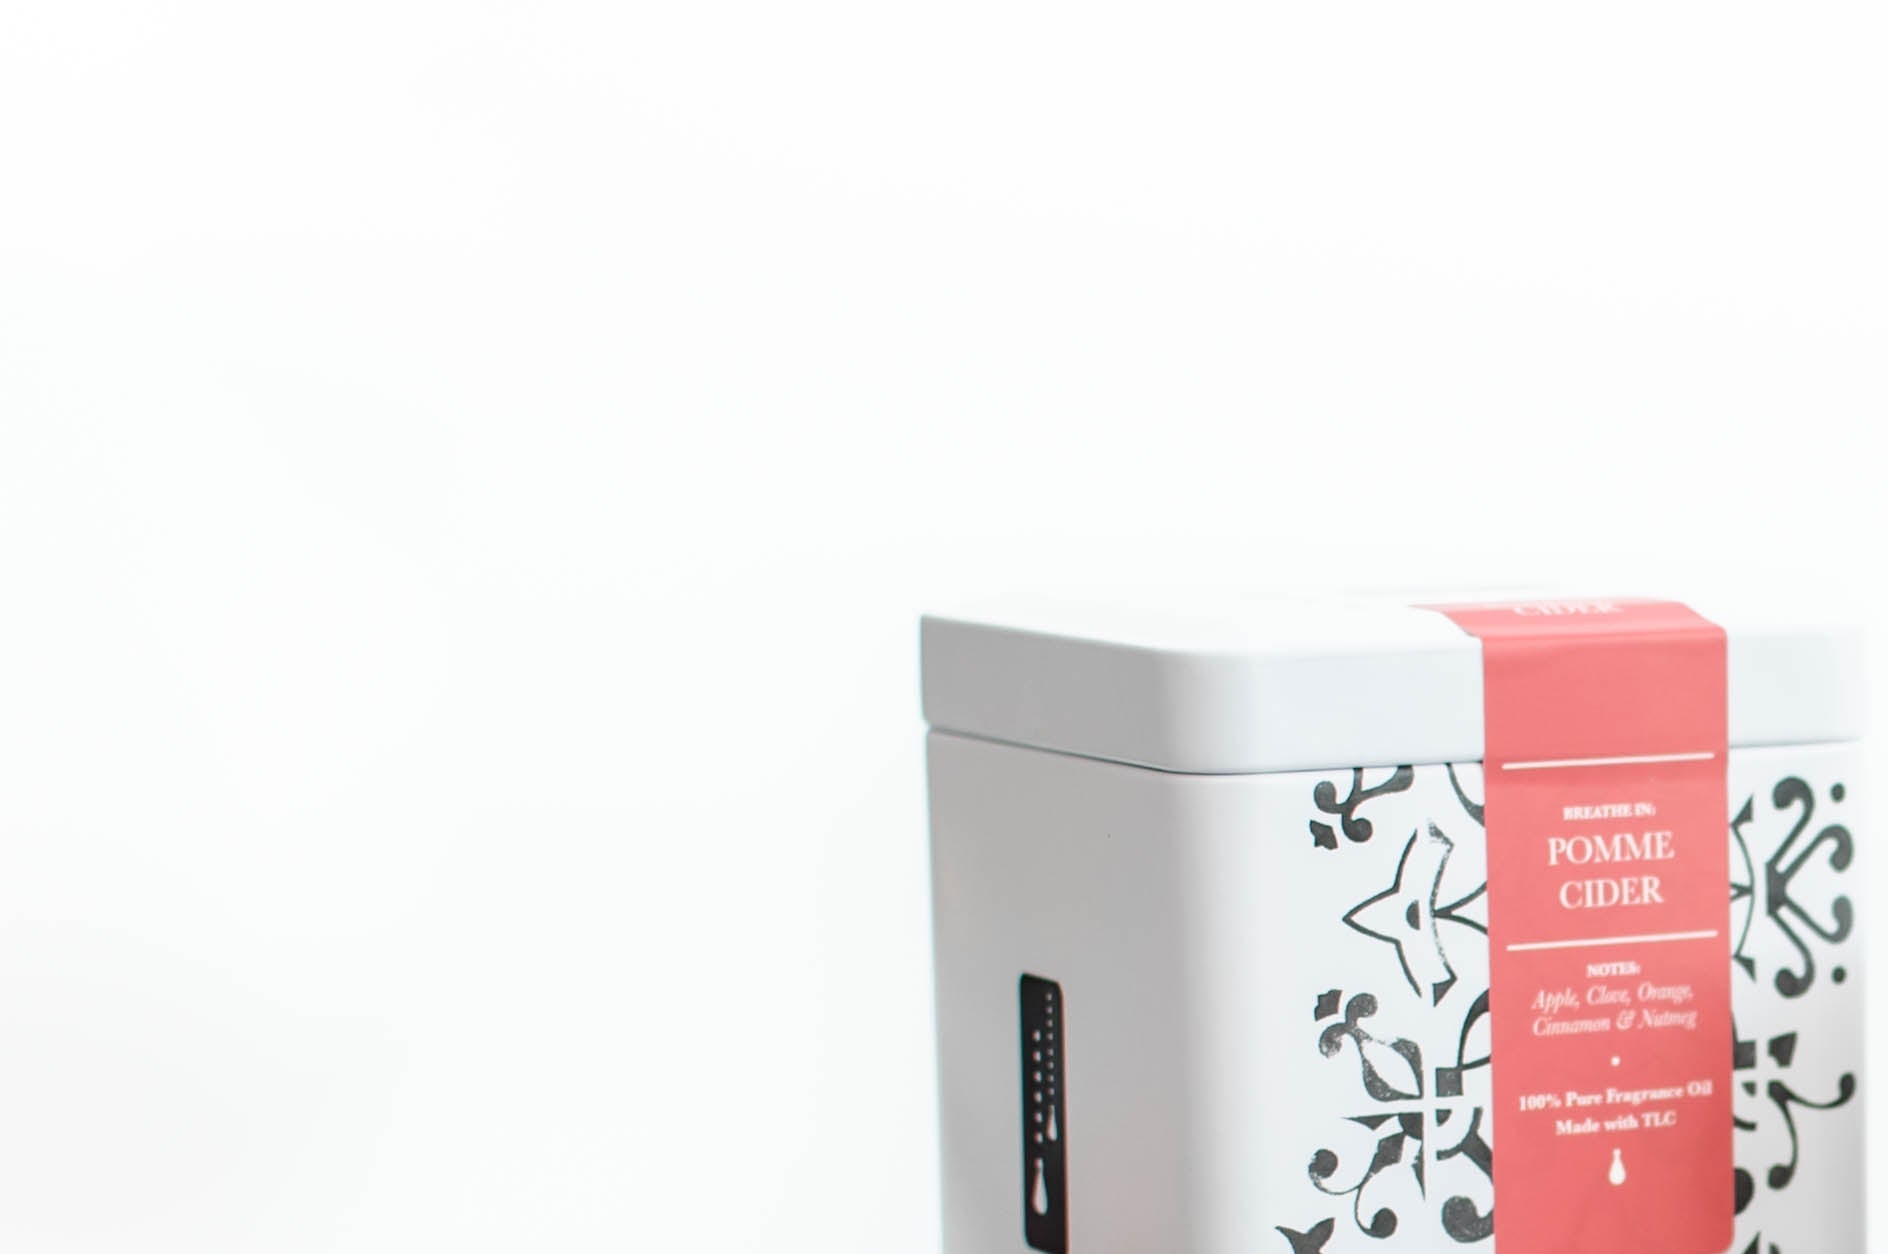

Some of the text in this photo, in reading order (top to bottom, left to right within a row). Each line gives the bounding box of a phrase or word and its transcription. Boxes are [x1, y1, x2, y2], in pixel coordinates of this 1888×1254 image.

[1563, 802, 1656, 820] BREATHE IN:
[1548, 830, 1675, 866] POMME
[1559, 875, 1664, 909] CIDER
[1587, 961, 1641, 978] NOTES:
[1531, 981, 1694, 1014] Apple, Clove, Orange,
[1533, 1008, 1698, 1036] Cinnamon & Nutmeg
[1519, 1080, 1713, 1111] 100% Pure Fragrance Oil
[1556, 1111, 1677, 1135] Made with TLC
